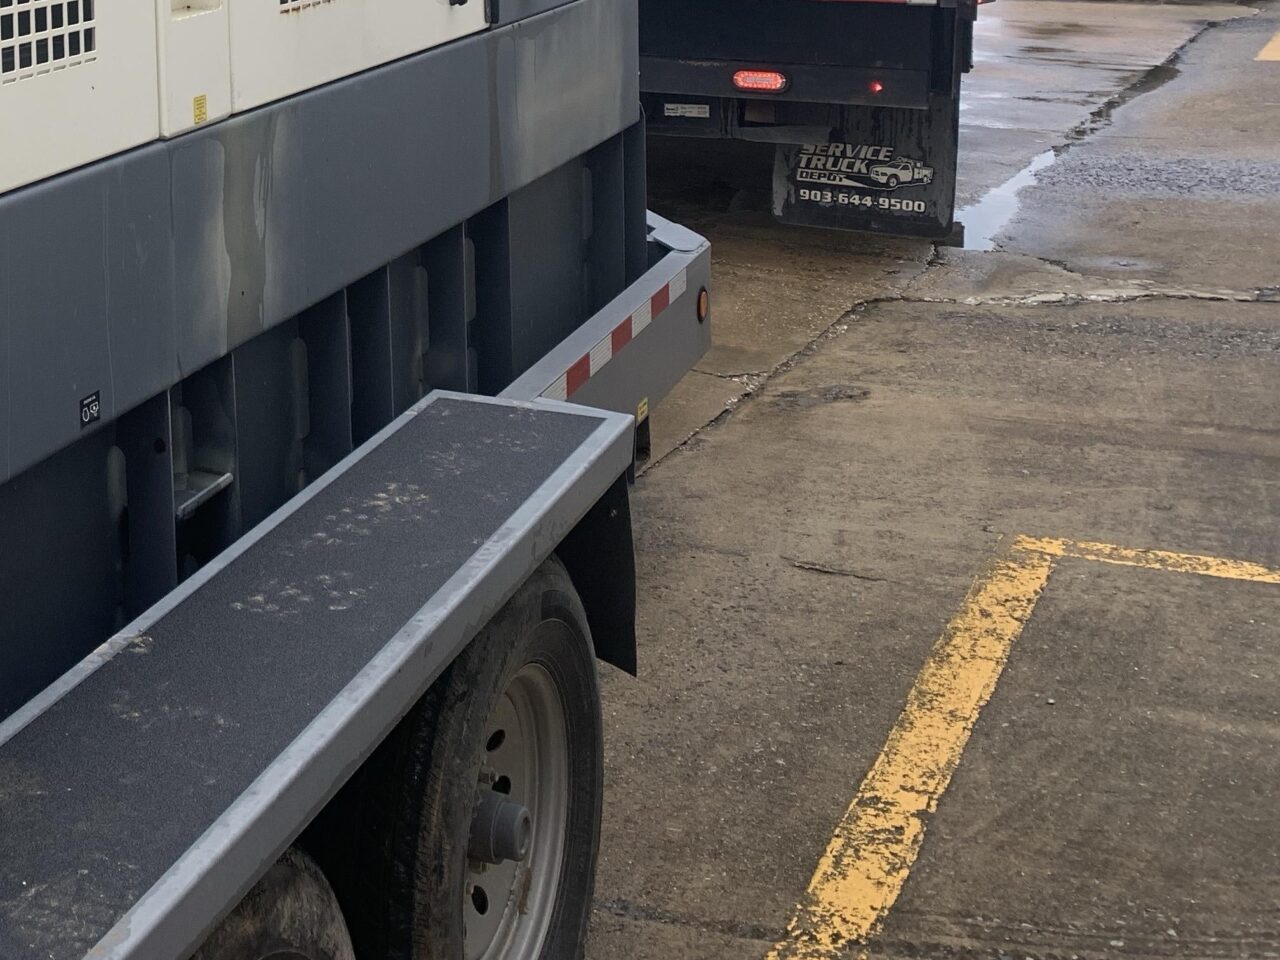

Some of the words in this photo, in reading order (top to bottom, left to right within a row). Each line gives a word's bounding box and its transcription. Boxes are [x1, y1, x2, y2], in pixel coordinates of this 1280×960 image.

[799, 142, 894, 160] SERVICE
[799, 154, 869, 174] TRUCK
[799, 169, 848, 182] DEPOT
[800, 189, 926, 212] 903-644-9500
